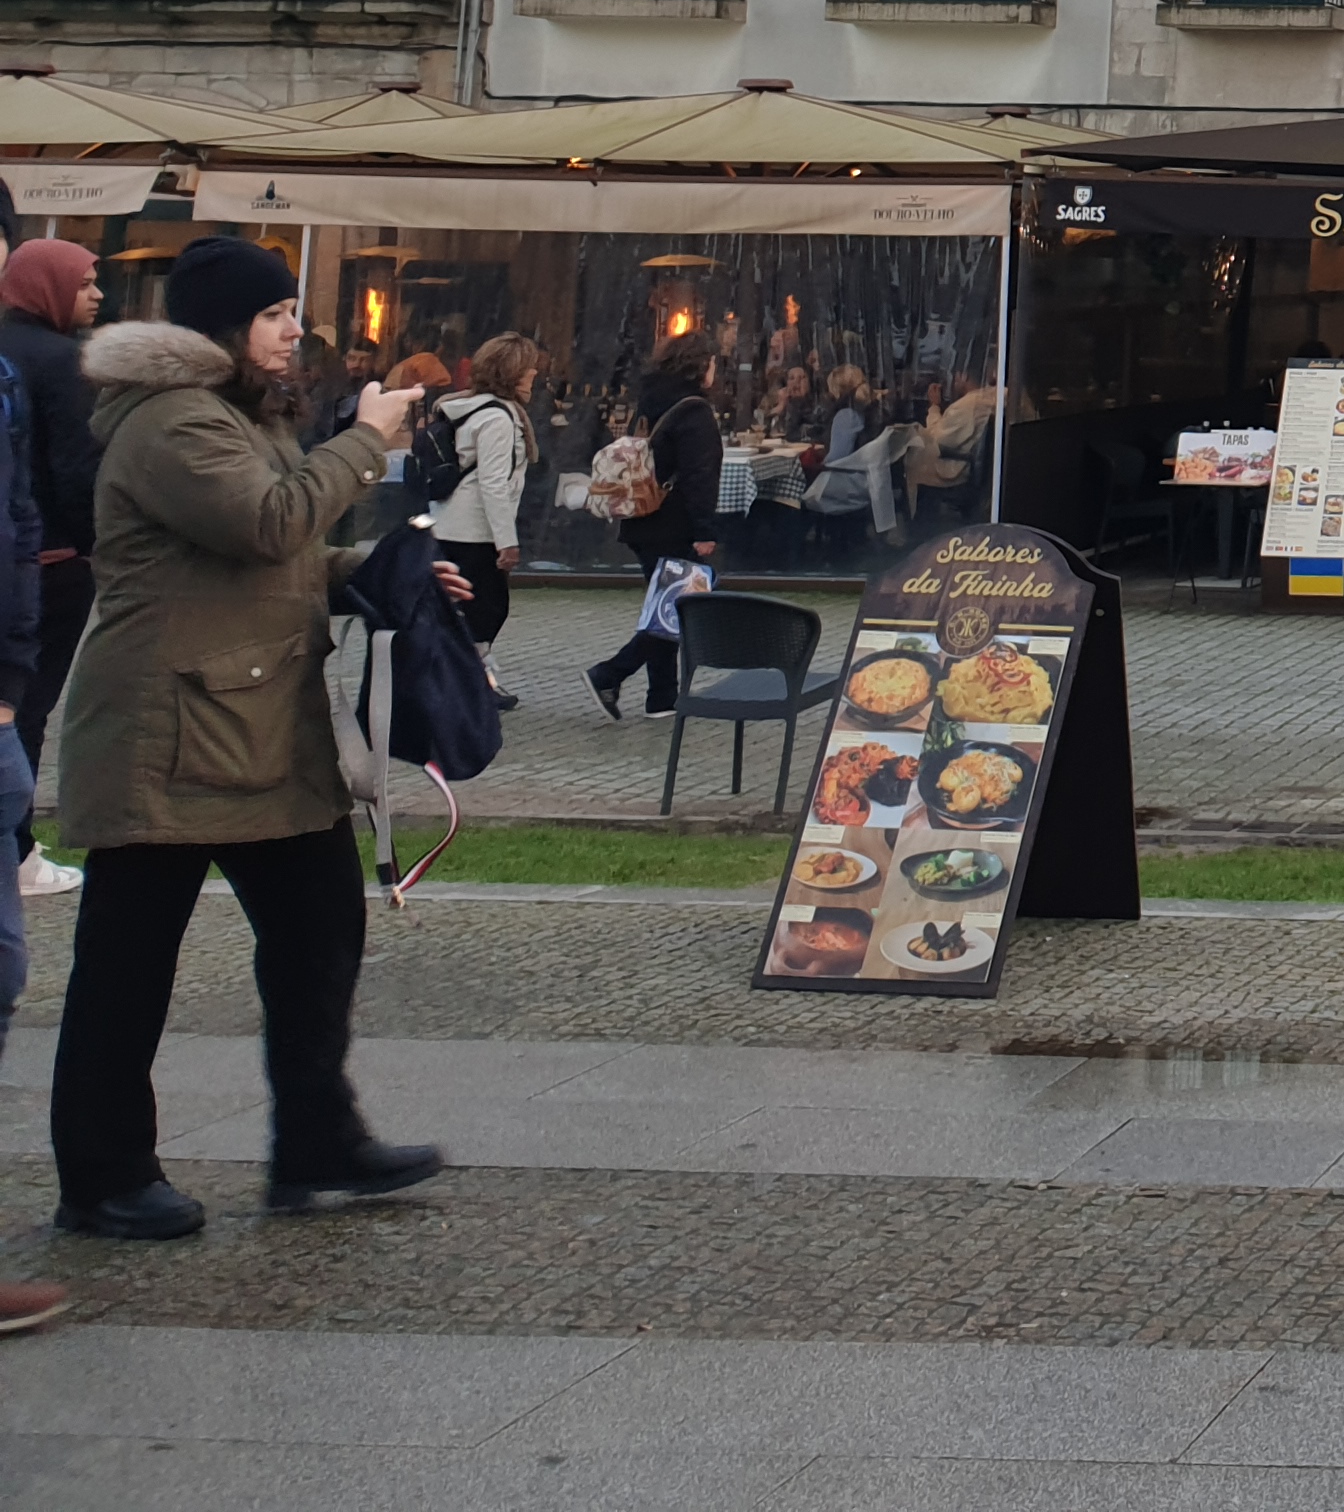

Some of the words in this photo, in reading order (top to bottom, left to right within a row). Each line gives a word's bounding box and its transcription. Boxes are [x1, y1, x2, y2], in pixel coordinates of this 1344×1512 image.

[1056, 204, 1106, 223] SAGRES
[1222, 434, 1249, 445] TAPAS
[936, 536, 1043, 564] Sabores
[902, 568, 942, 594] da
[949, 570, 1055, 599] Fininha
